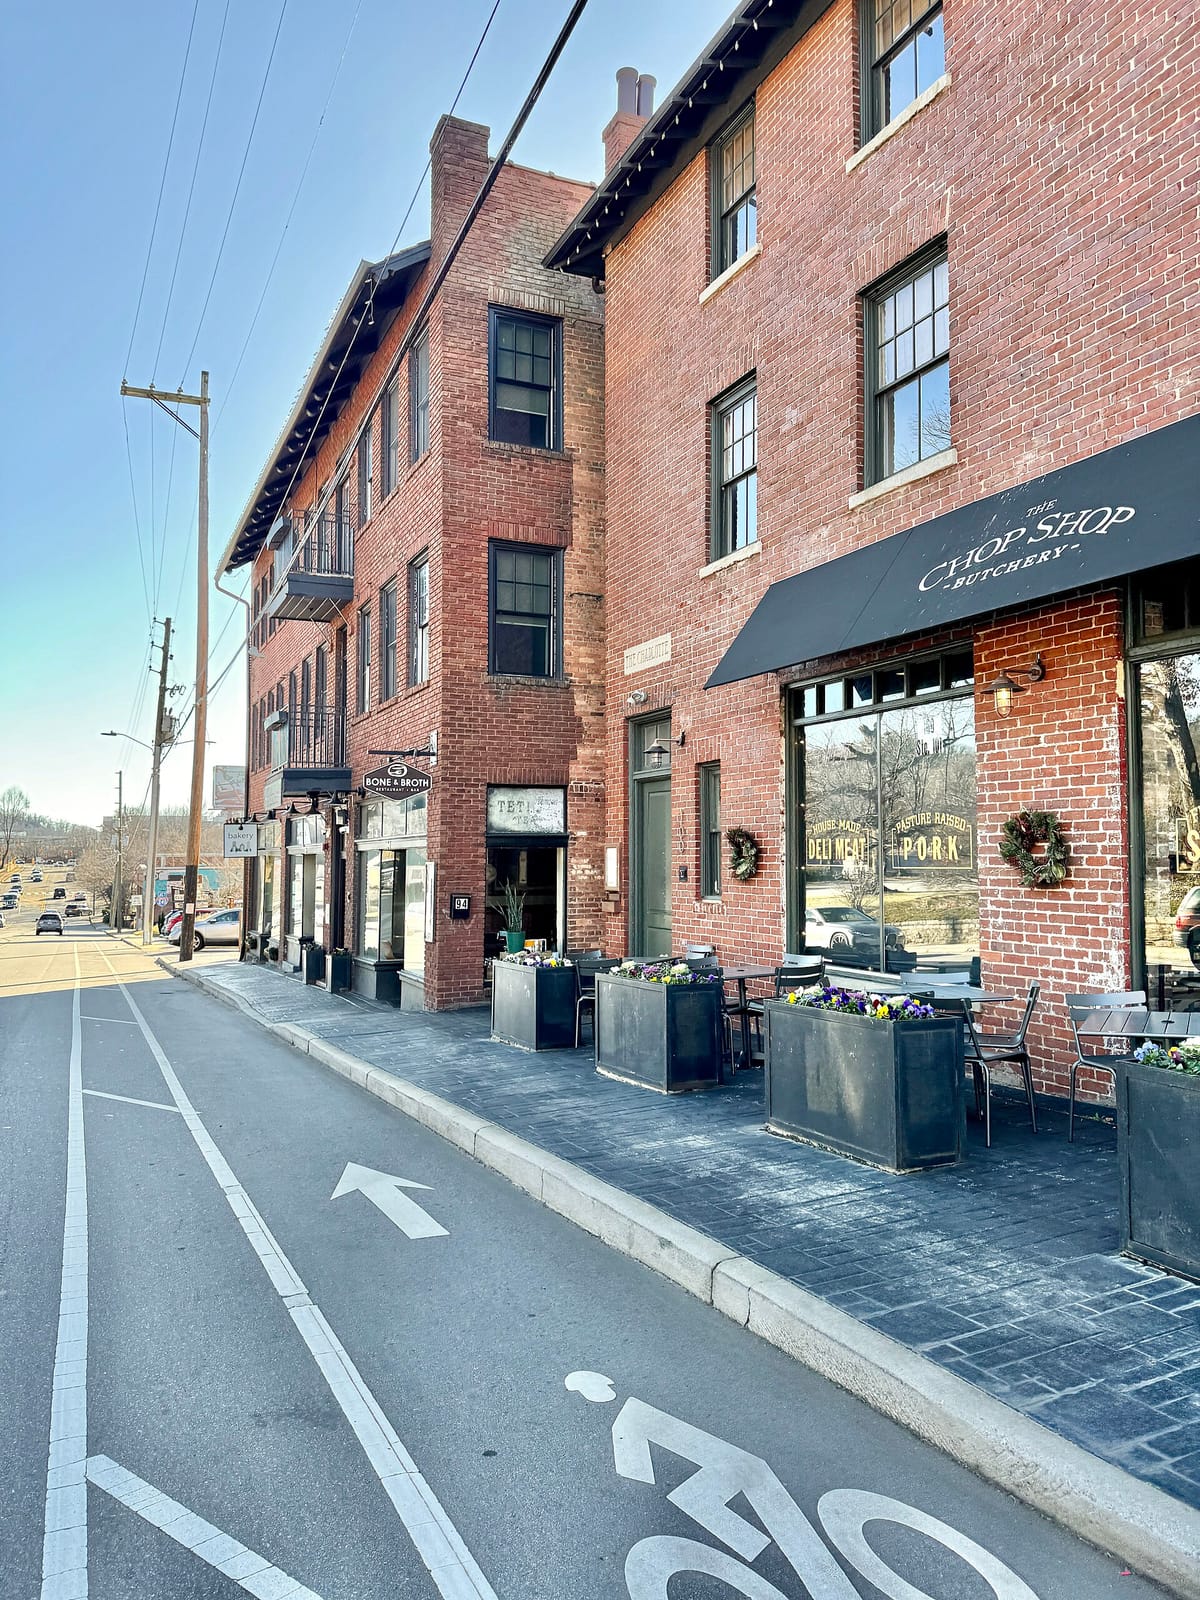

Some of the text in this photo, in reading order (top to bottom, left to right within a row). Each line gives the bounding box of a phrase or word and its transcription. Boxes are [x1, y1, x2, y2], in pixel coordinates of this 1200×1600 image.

[1025, 499, 1057, 518] THE
[917, 506, 1136, 592] CHOP SHOP
[366, 777, 391, 786] BONE
[400, 778, 429, 787] BROTH
[812, 819, 861, 834] HOUSE MADE
[895, 812, 966, 833] PASTURE RAISED
[227, 831, 254, 841] bakery
[808, 838, 866, 860] DELI MEAT
[903, 835, 959, 861] PORK
[456, 899, 467, 909] 94
